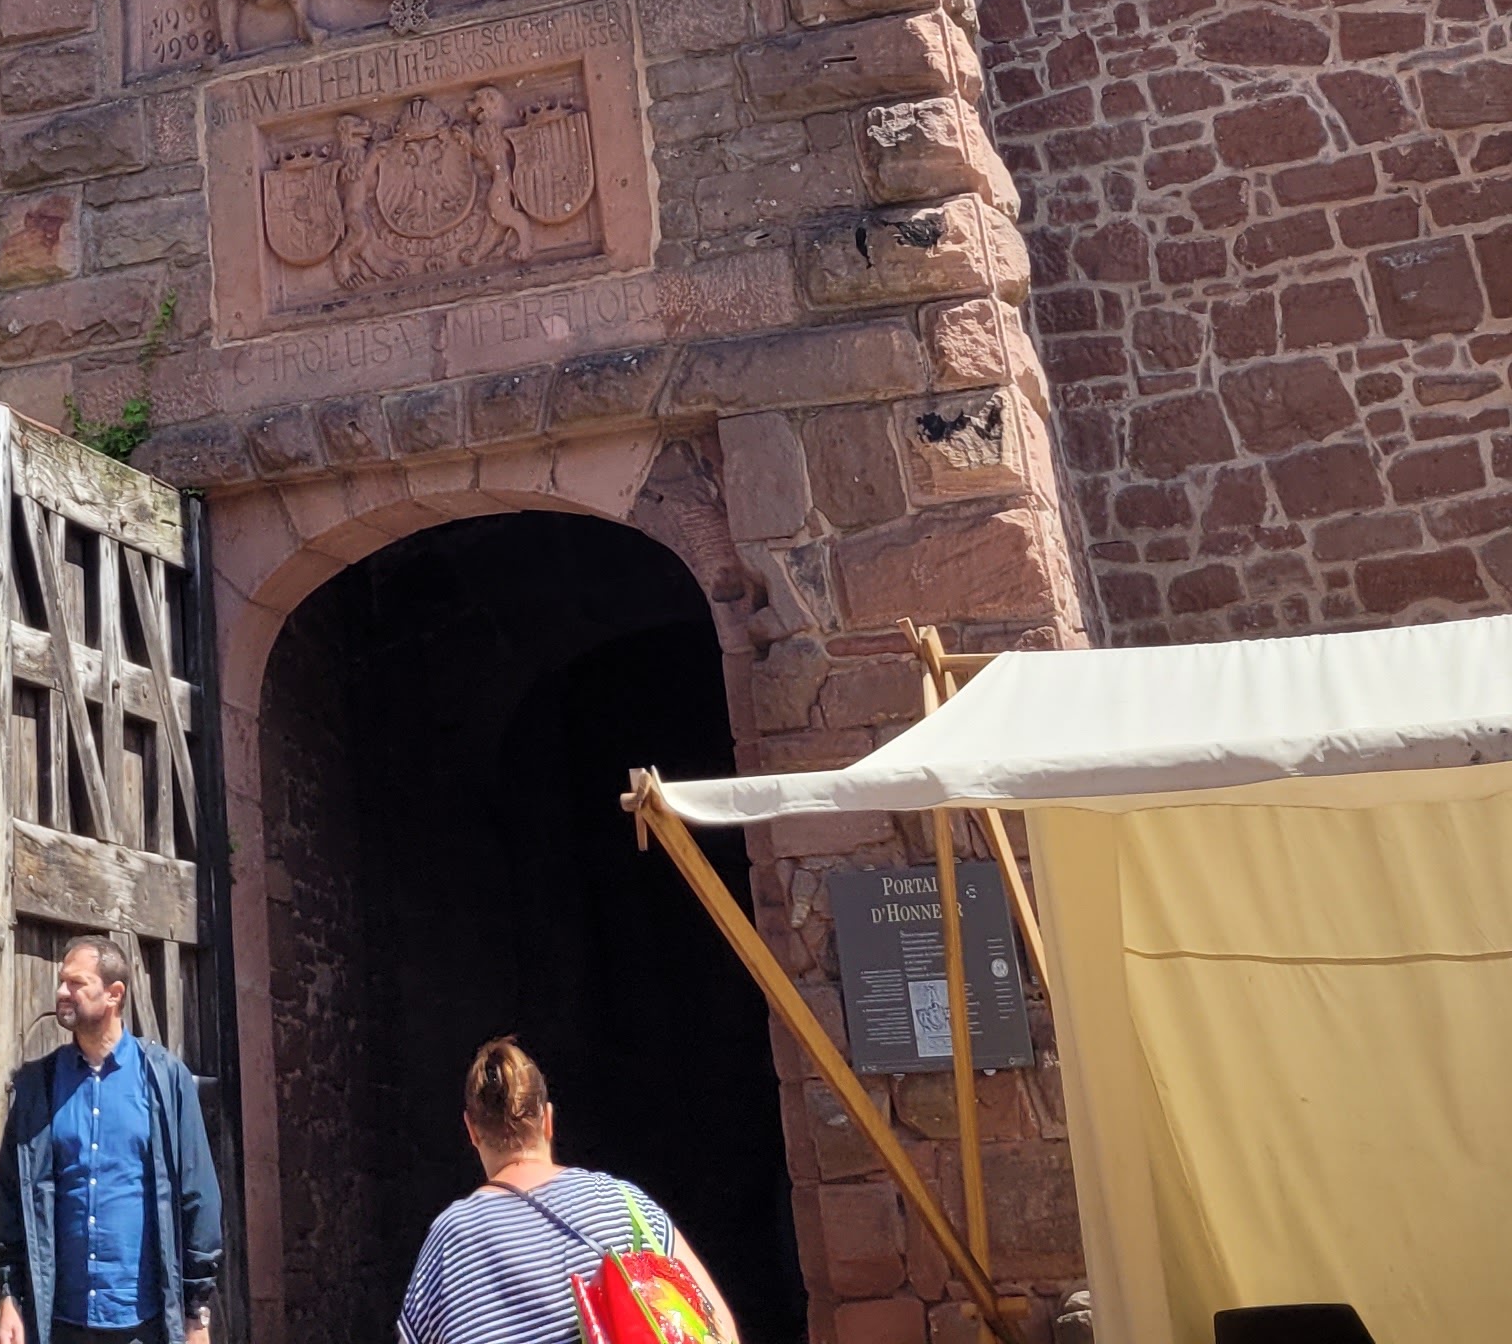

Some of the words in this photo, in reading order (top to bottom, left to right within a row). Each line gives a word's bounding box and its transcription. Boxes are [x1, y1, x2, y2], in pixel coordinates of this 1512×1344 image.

[152, 28, 218, 64] 1908
[881, 876, 940, 896] PORTAI
[870, 902, 964, 924] D'HONNER
